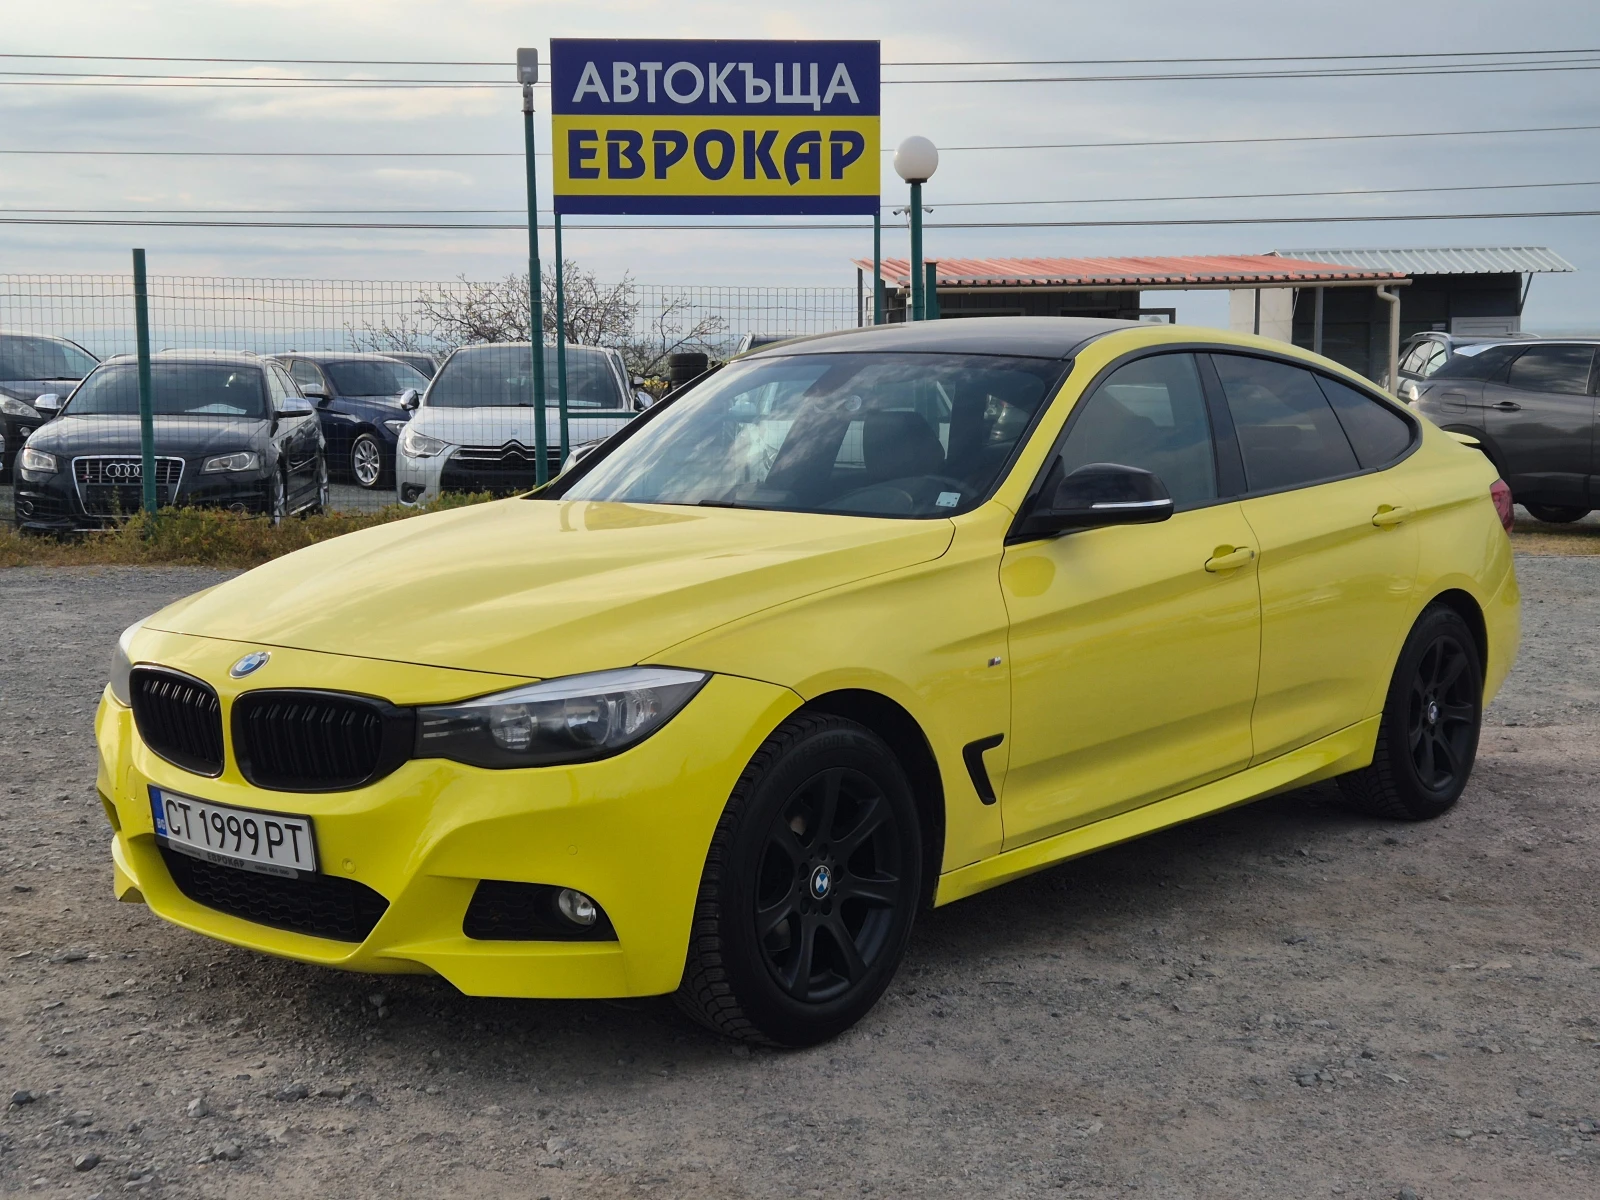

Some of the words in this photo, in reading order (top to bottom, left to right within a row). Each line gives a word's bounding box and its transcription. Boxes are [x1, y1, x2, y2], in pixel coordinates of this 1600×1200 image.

[572, 61, 860, 111] АВТОКЪЩА
[567, 129, 865, 186] ЕВРОКАР
[156, 817, 166, 830] BG
[165, 798, 191, 840] CT
[199, 809, 259, 855] 1999
[264, 820, 302, 863] PT
